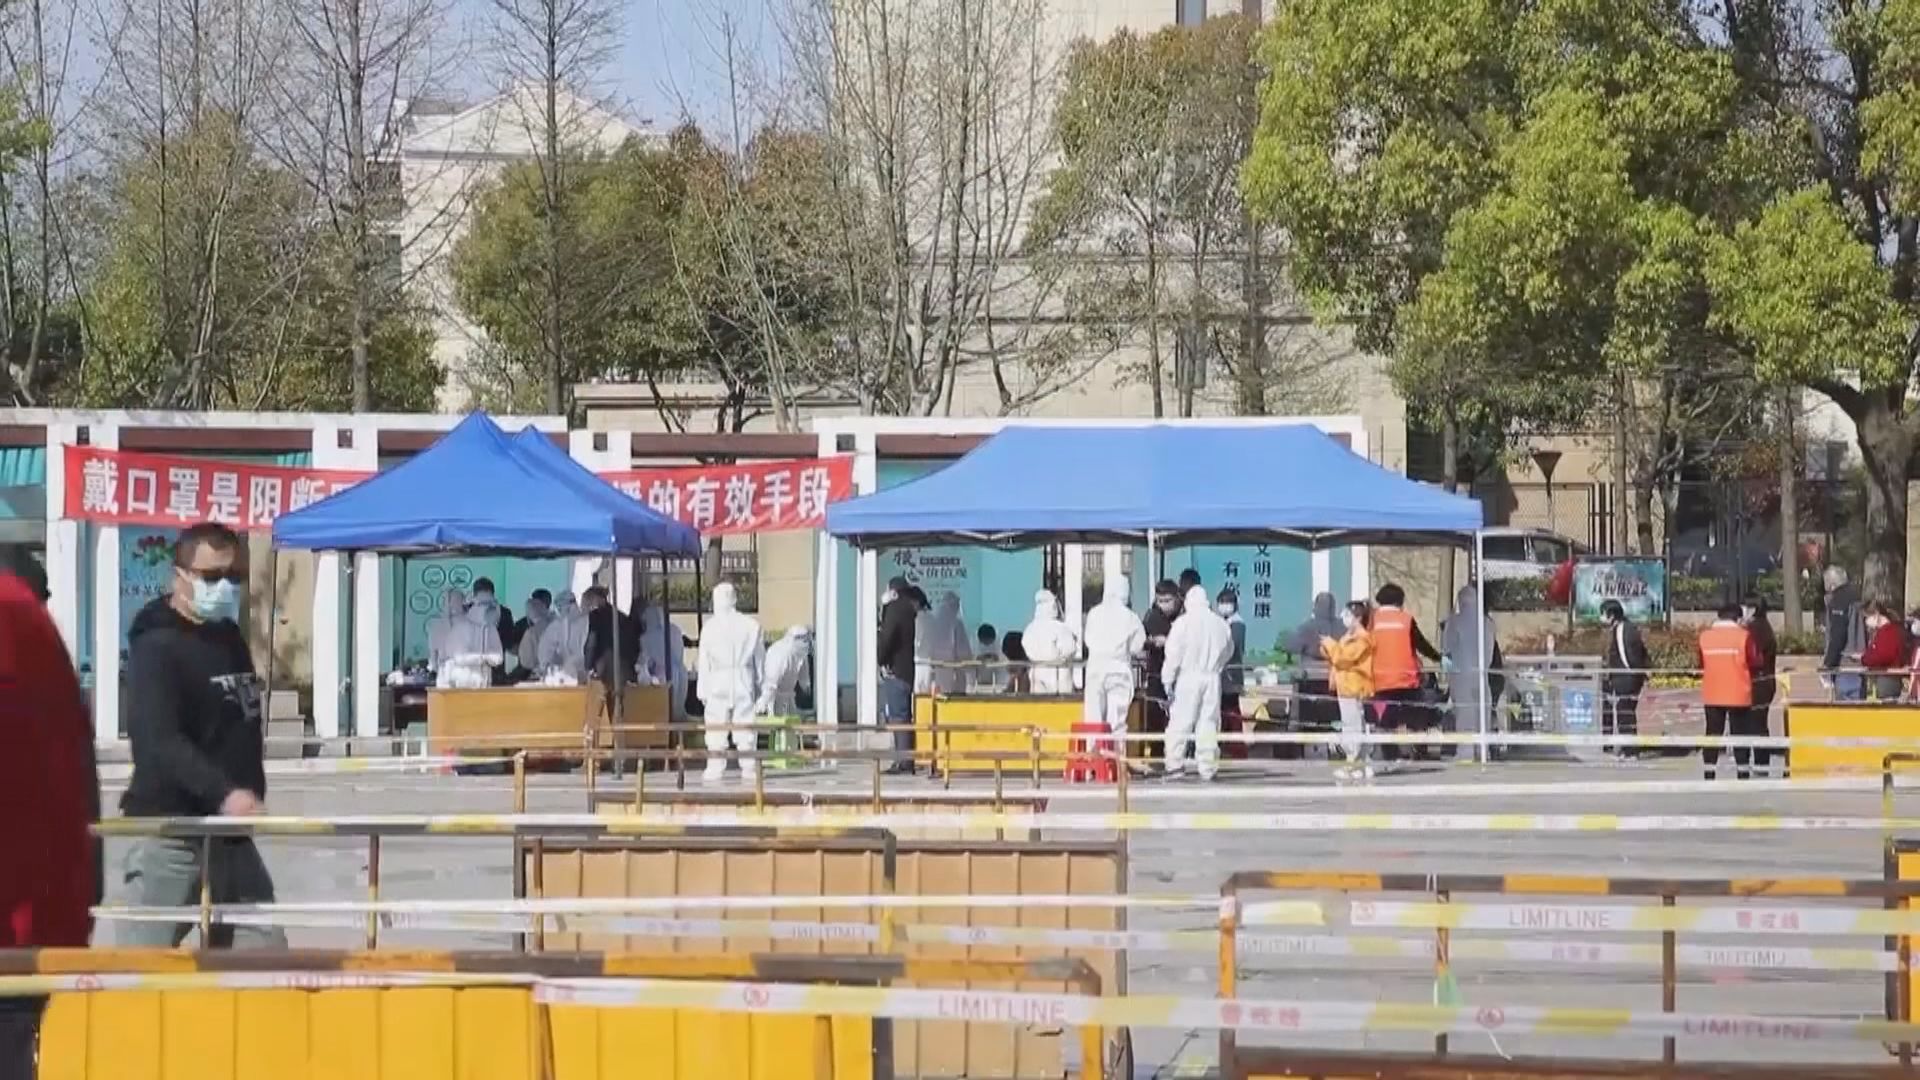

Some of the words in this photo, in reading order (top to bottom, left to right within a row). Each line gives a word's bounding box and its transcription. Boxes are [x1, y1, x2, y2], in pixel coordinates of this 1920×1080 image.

[82, 457, 358, 526] 戴口罩是阻断
[1508, 908, 1611, 929] LIMITLINE
[937, 994, 1067, 1025] LIMITLINE
